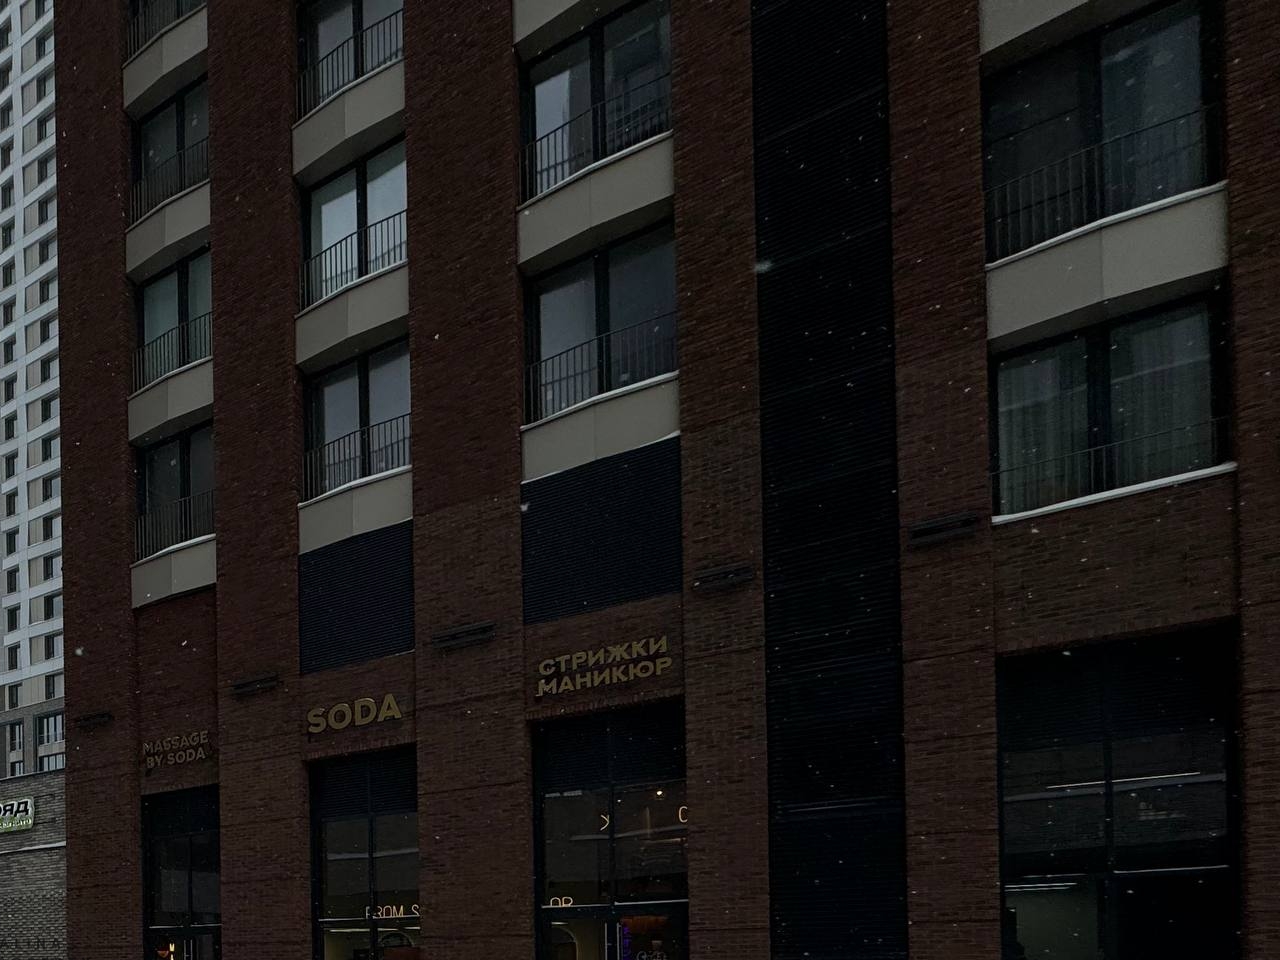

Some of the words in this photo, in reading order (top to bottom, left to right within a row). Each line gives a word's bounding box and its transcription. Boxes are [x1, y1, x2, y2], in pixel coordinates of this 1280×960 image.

[538, 635, 667, 675] СТРИЖКИ
[535, 657, 672, 697] МАНИКЮР
[307, 693, 402, 733] SODA
[142, 730, 209, 755] MASSAGE
[146, 754, 164, 769] BY
[167, 746, 206, 765] SODA
